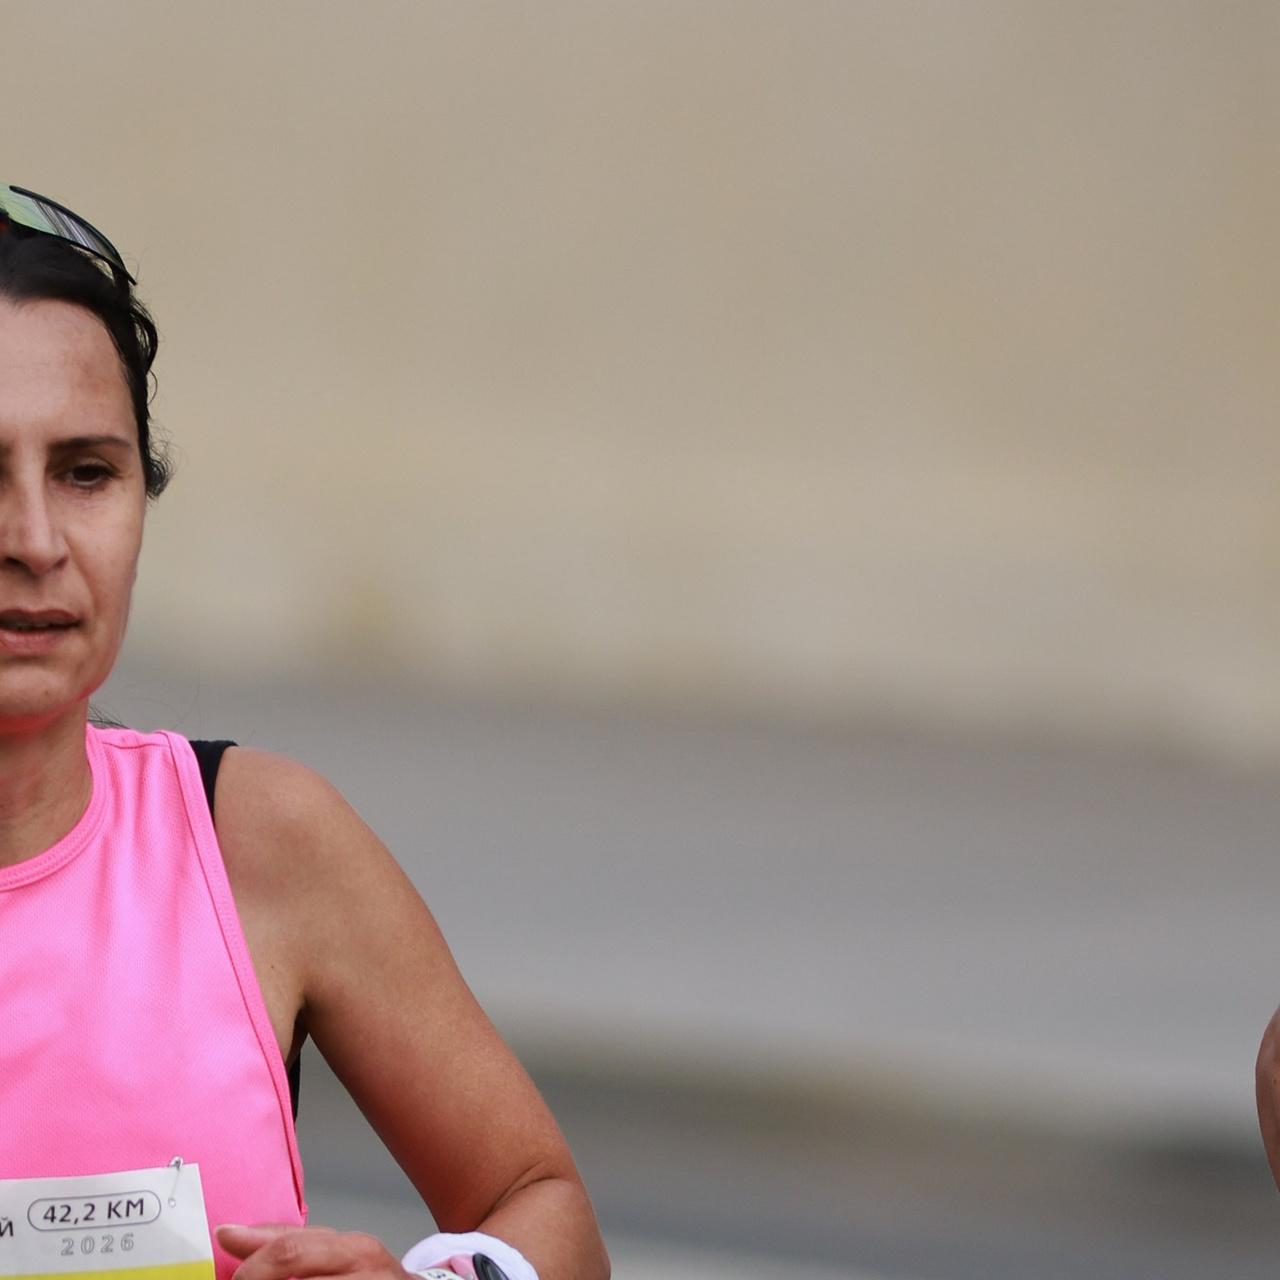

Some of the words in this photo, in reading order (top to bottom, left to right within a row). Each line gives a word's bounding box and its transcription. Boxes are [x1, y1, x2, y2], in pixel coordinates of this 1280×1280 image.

[43, 1203, 96, 1225] 42,2
[107, 1198, 144, 1219] КМ
[60, 1232, 134, 1256] 2026
